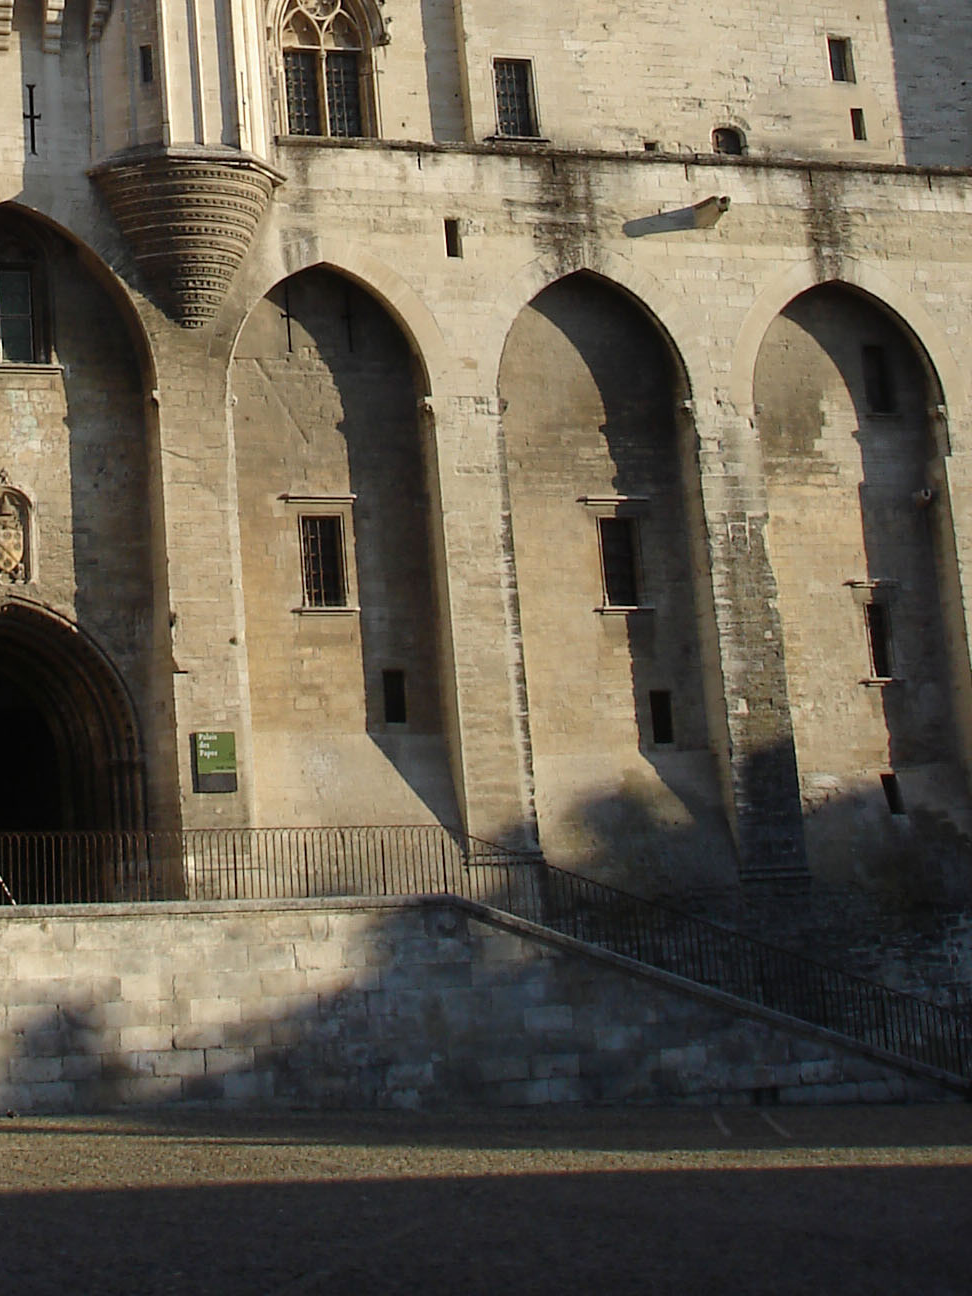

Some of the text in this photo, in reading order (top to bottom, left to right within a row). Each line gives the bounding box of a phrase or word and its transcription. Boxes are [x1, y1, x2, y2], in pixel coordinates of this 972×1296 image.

[198, 733, 217, 741] Palais
[199, 741, 210, 749] des
[199, 749, 218, 759] Papes
